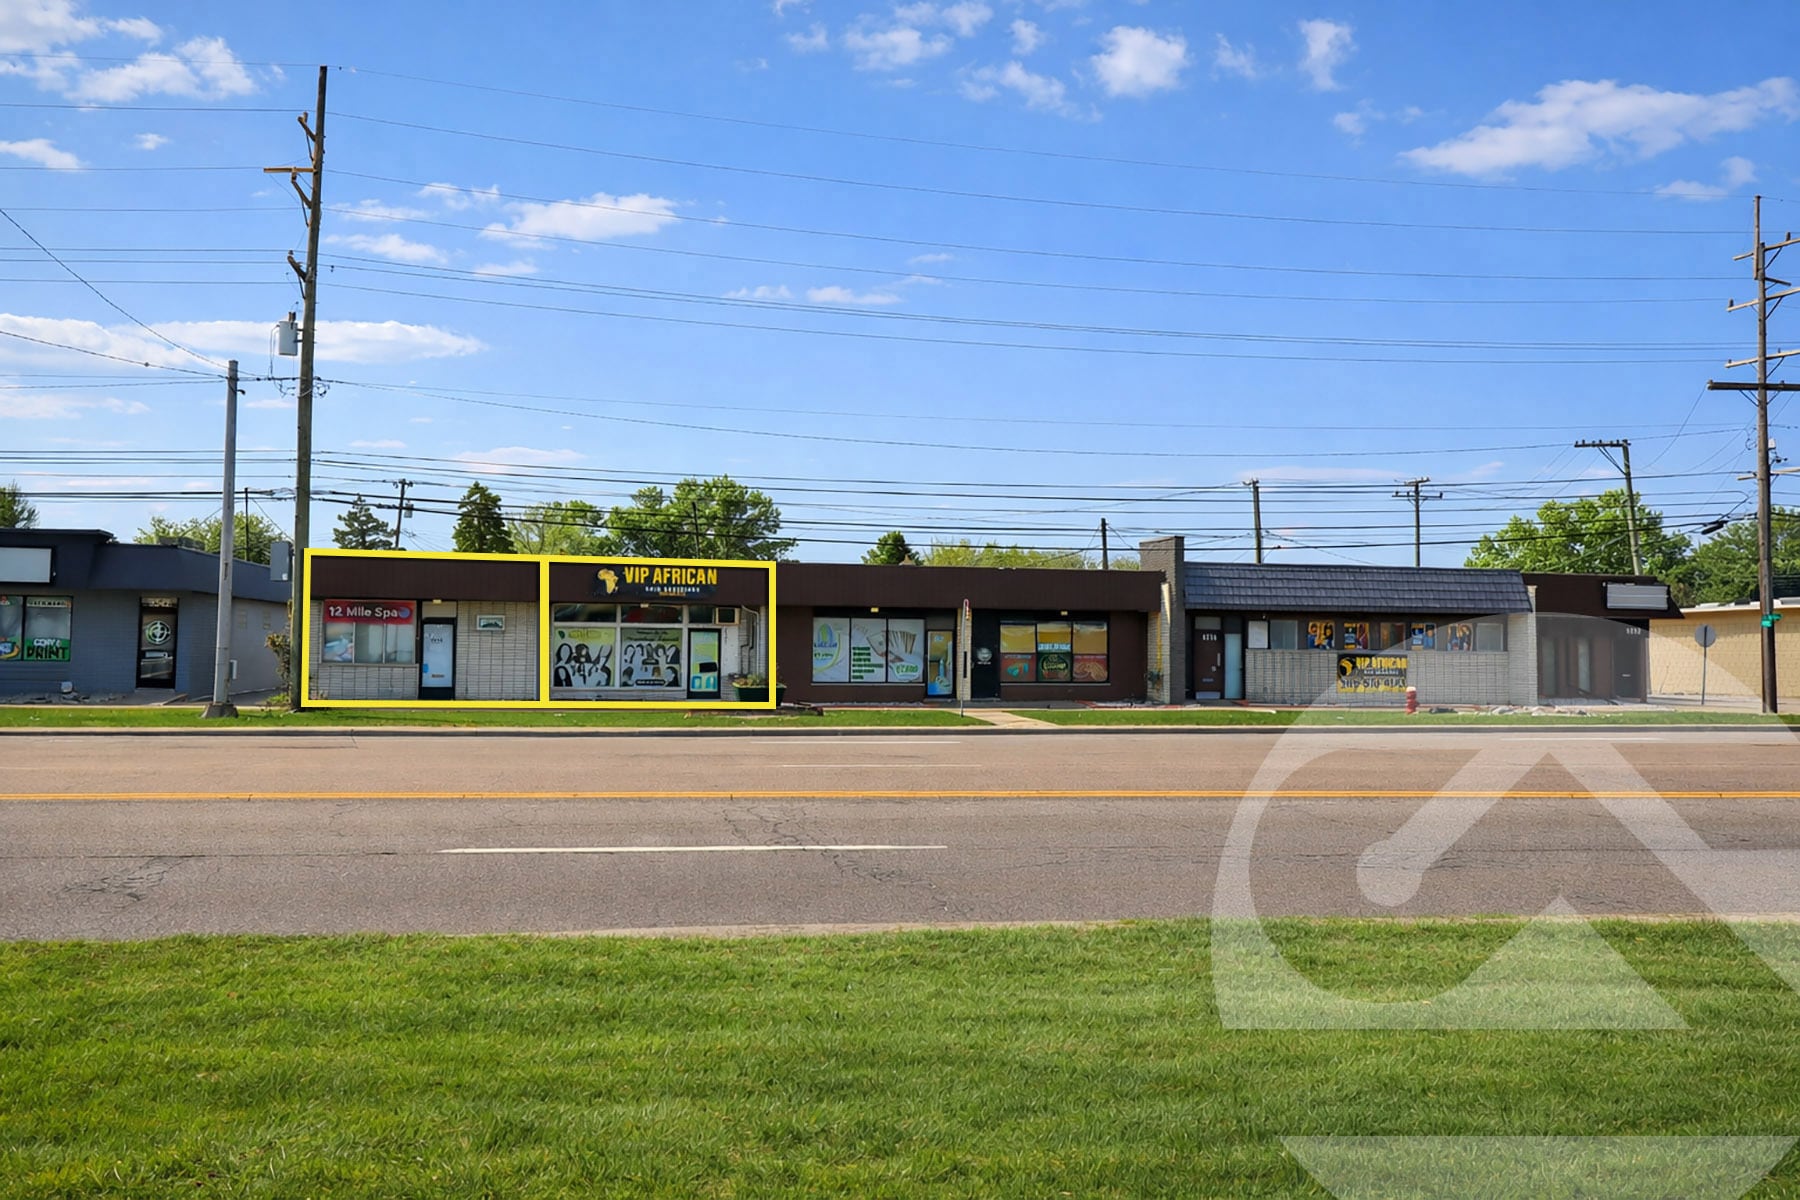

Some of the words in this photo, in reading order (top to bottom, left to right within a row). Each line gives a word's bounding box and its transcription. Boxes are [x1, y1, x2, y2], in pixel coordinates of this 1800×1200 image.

[624, 566, 650, 584] VIP
[652, 567, 718, 585] AFRICAN
[329, 606, 344, 617] 12
[346, 606, 372, 617] Mile
[374, 607, 399, 620] Spa
[26, 646, 69, 660] PRINT
